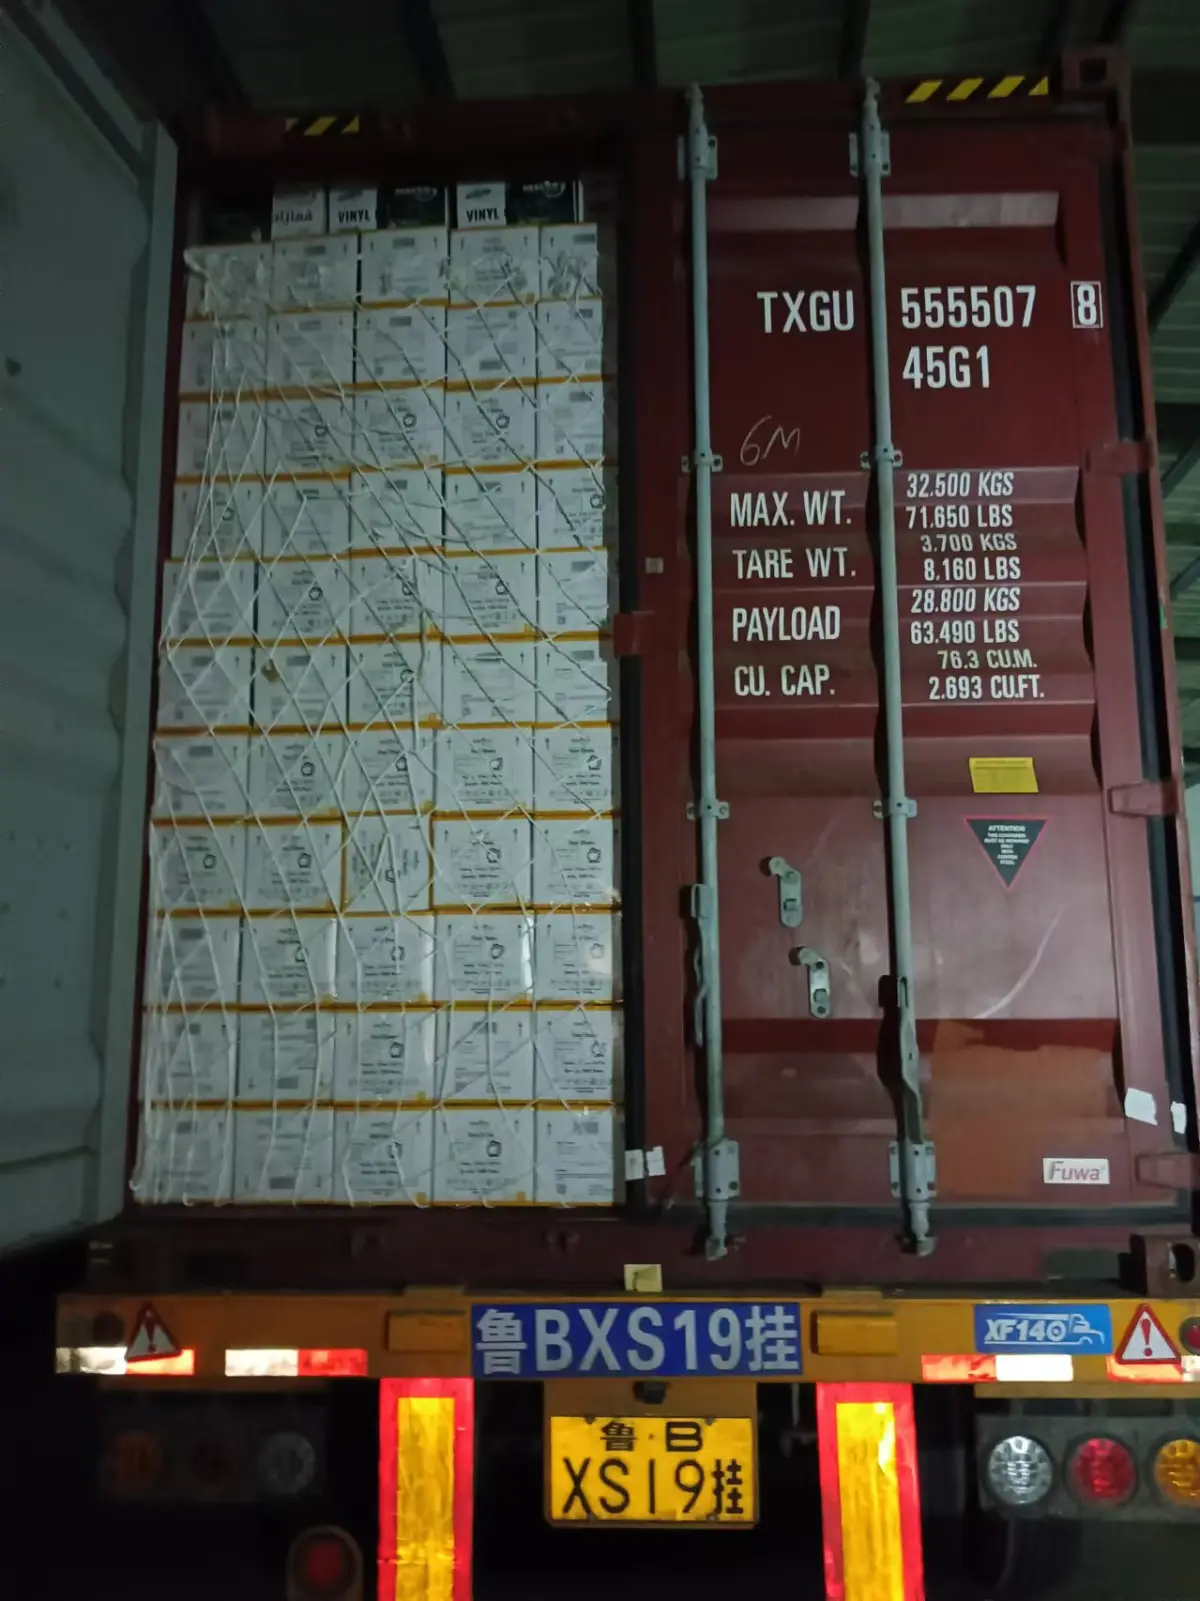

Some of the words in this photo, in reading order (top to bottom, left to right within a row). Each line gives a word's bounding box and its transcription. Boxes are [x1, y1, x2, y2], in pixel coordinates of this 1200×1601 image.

[338, 209, 371, 225] VINYL
[466, 207, 501, 223] VINYL
[756, 290, 855, 334] TXGU
[900, 284, 1037, 329] 555507
[1076, 283, 1098, 327] 8
[902, 345, 990, 389] 45G1
[978, 471, 1015, 497] KGS
[730, 491, 796, 528] MAX.
[803, 490, 852, 526] WT.
[977, 504, 1013, 528] LBS
[980, 532, 1017, 552] KGS
[732, 549, 794, 580] TARE
[806, 547, 857, 578] WT.
[984, 556, 1021, 581] LBS
[983, 587, 1021, 612] KGS
[732, 606, 841, 642] PAYLOAD
[983, 619, 1020, 644] LBS
[937, 650, 980, 671] 76.3
[734, 666, 770, 696] CU.
[781, 664, 836, 696] CAP.
[1047, 1160, 1101, 1182] Fuwa
[475, 1305, 800, 1375] 鲁BXS19挂
[984, 1318, 1067, 1343] XF140
[562, 1457, 744, 1515] XS19挂
